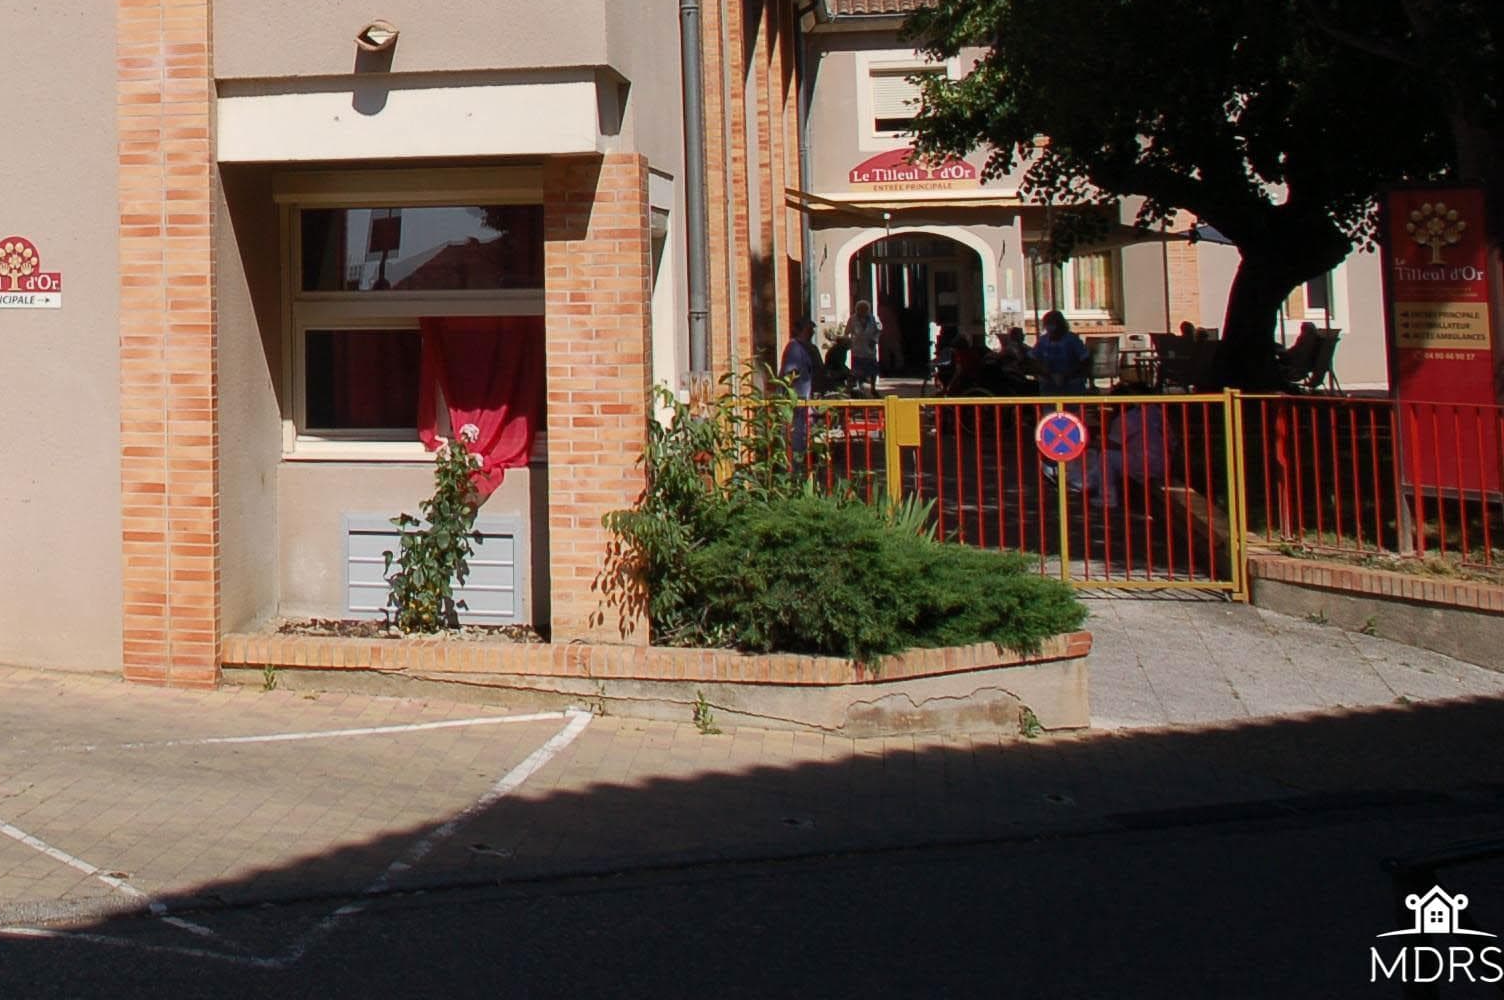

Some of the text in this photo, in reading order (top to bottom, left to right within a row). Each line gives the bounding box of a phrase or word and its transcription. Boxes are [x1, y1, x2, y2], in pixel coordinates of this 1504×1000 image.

[853, 165, 972, 182] Le Tilleul d'Or
[905, 181, 952, 192] PRINCIPALE
[1394, 265, 1485, 281] Tilleul d'Or
[26, 274, 59, 290] d'Or
